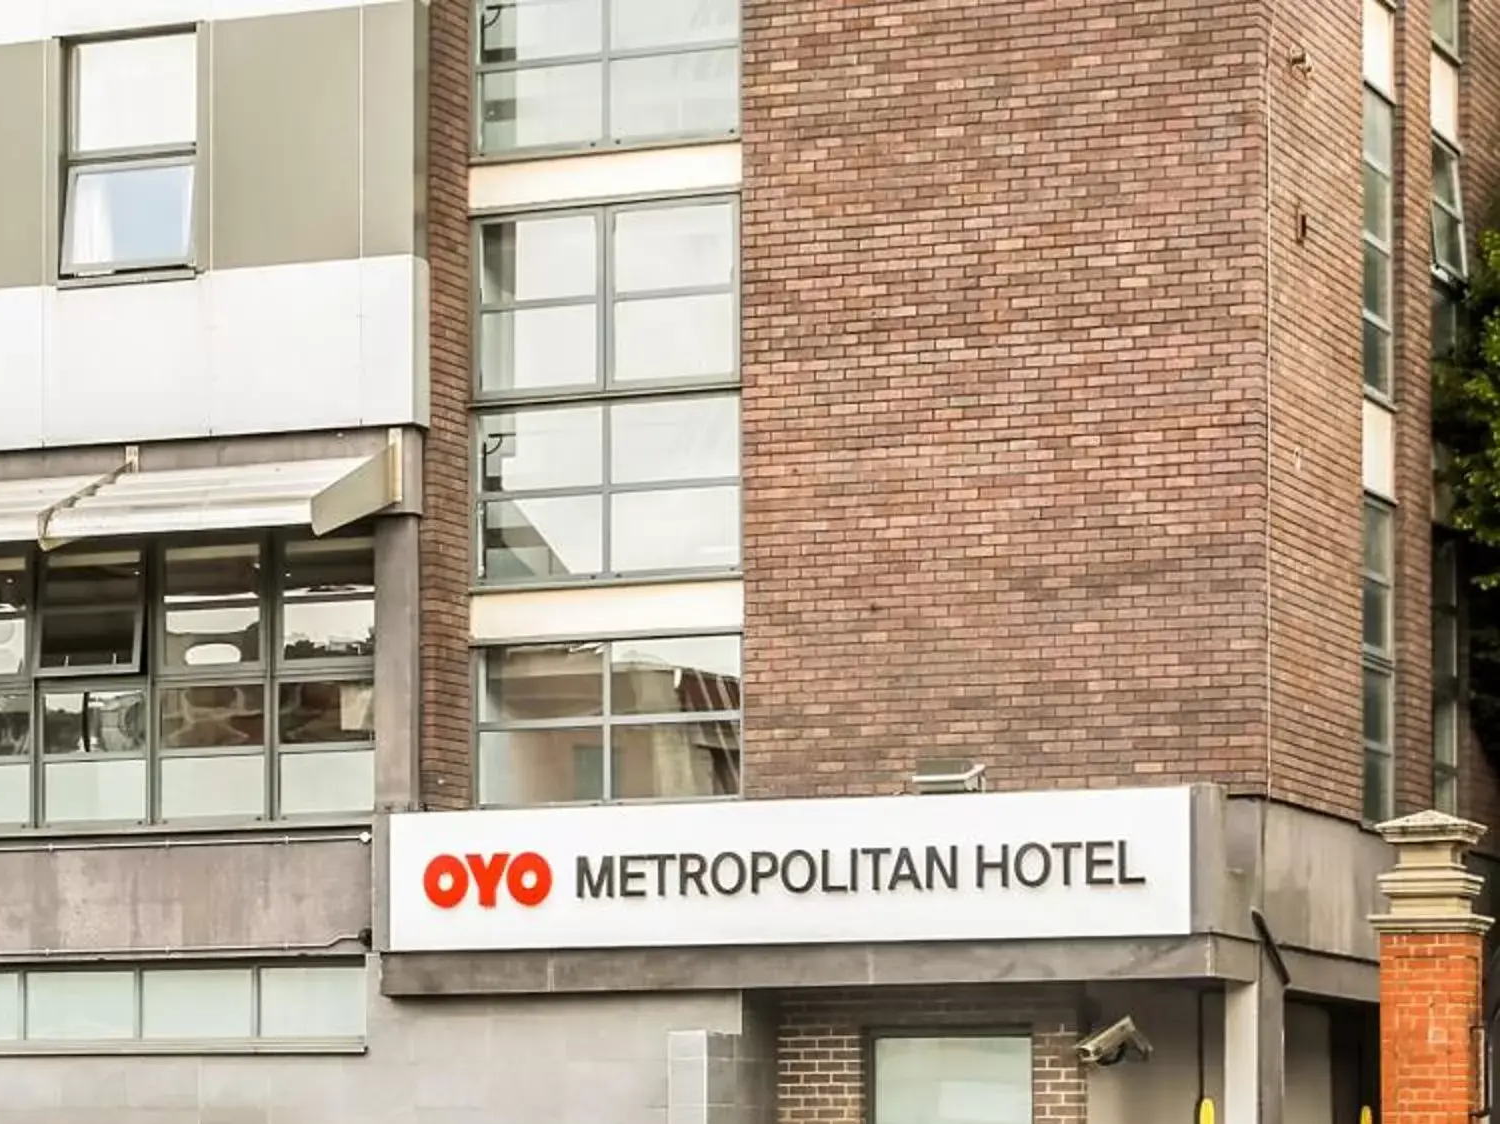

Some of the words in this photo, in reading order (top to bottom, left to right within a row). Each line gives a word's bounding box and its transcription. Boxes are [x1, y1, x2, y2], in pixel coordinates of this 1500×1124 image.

[423, 850, 553, 910] OYO
[575, 844, 958, 899] METROPOLITAN
[975, 839, 1146, 889] HOTEL
